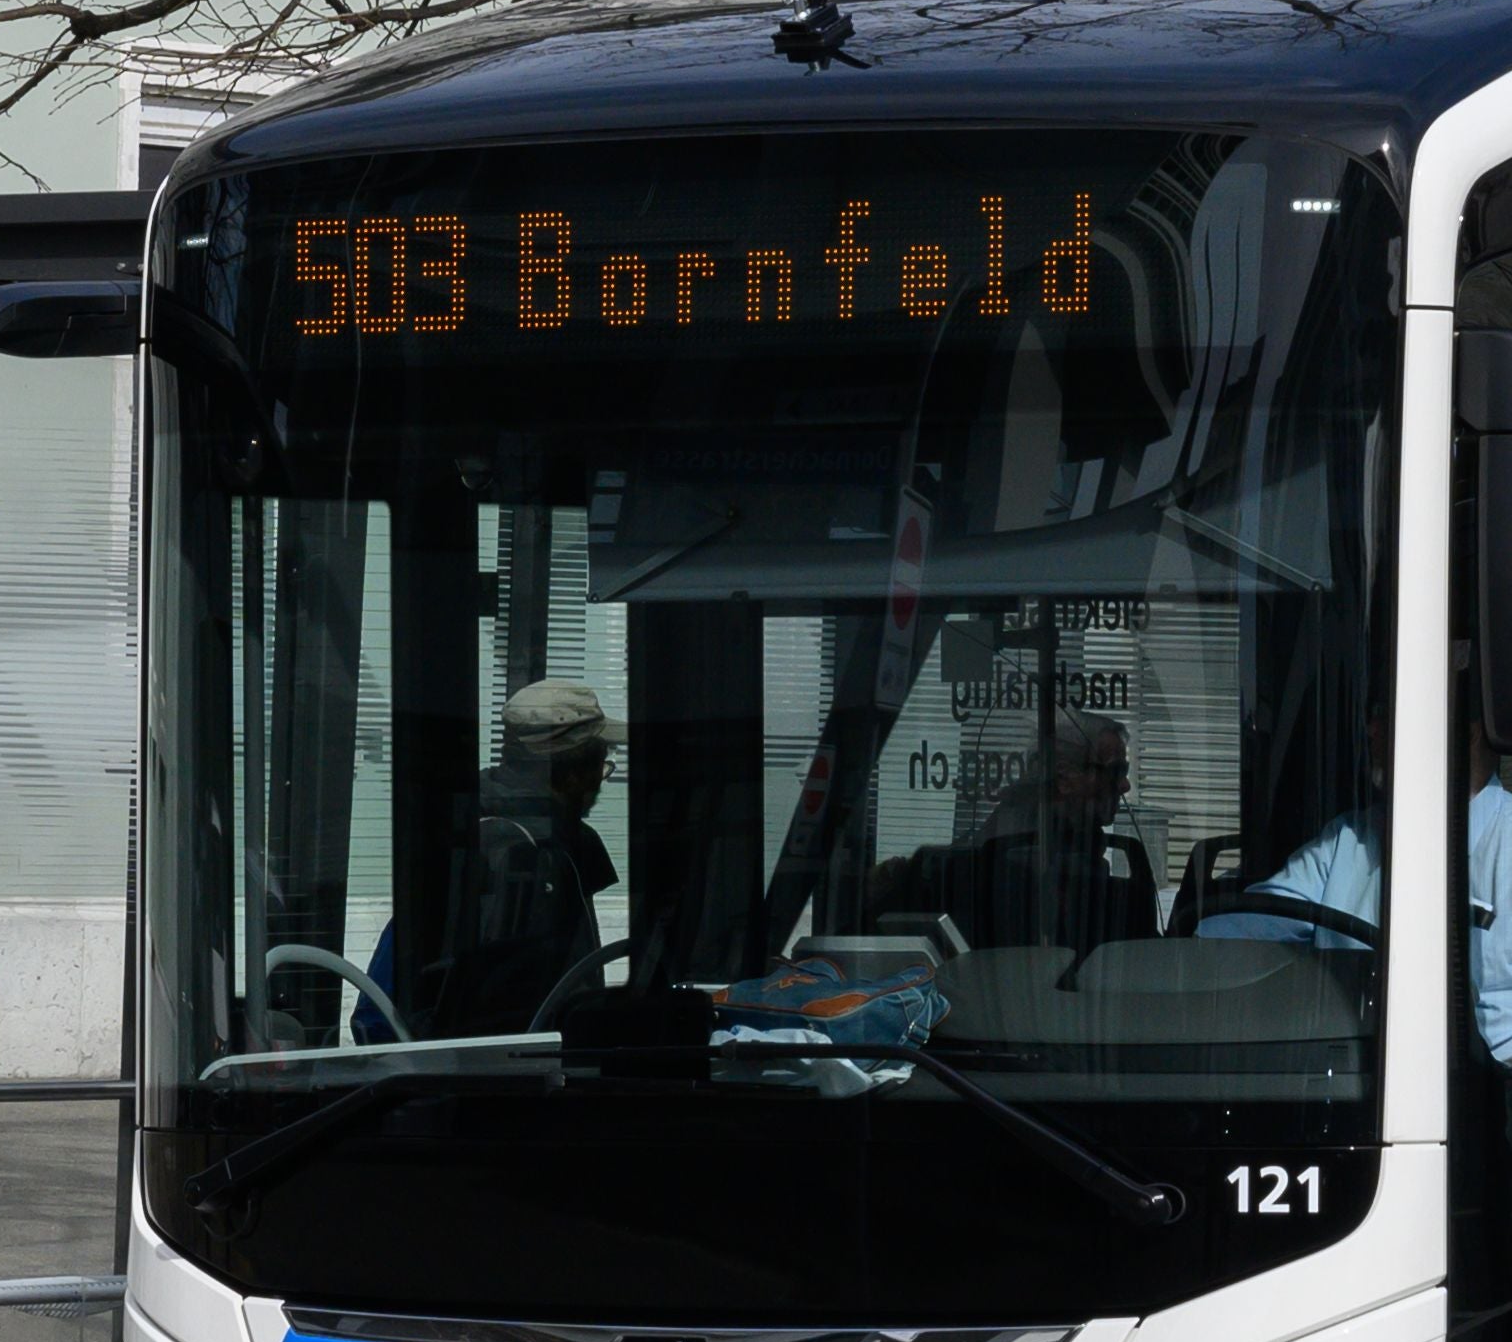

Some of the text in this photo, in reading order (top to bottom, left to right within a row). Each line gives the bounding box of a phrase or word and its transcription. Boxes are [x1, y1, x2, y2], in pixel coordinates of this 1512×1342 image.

[296, 193, 1090, 335] 503 Bornfeld
[1227, 1166, 1320, 1213] 121
